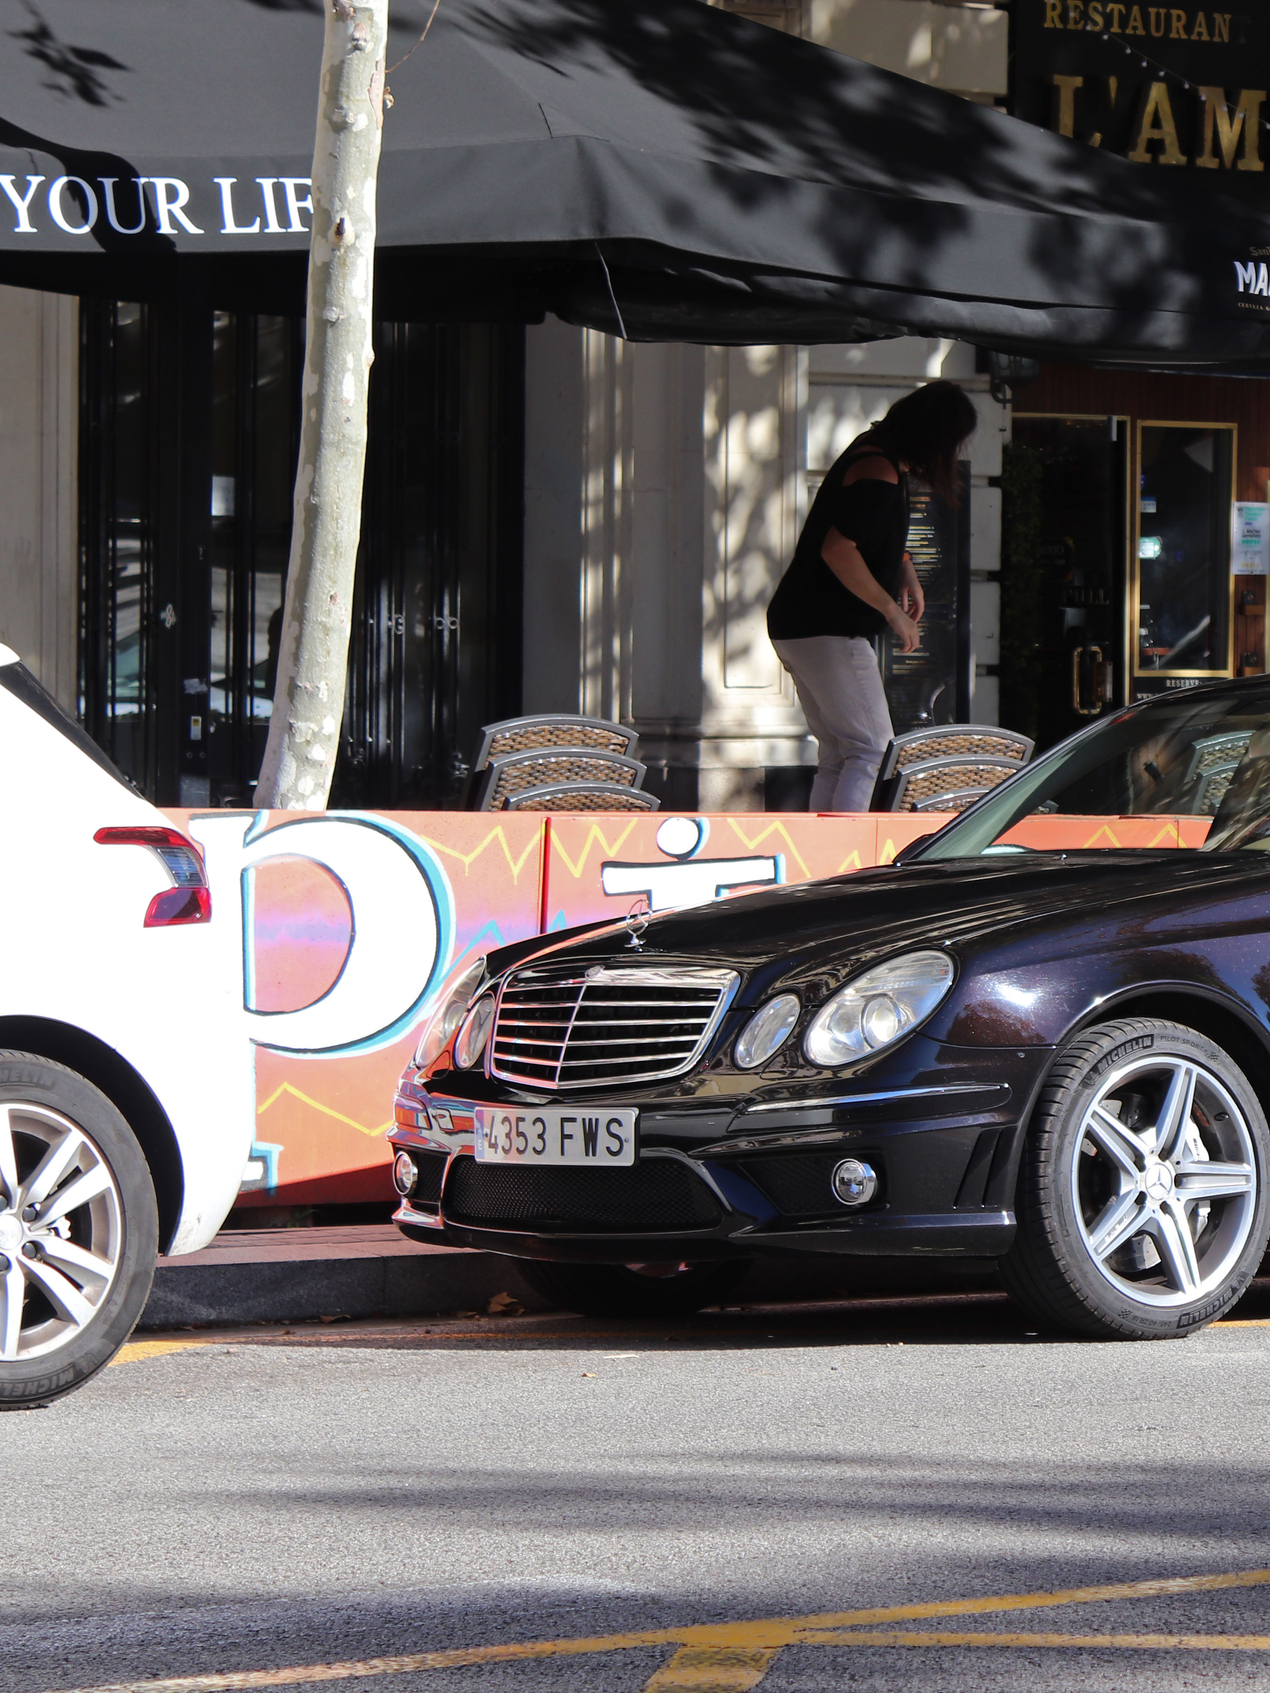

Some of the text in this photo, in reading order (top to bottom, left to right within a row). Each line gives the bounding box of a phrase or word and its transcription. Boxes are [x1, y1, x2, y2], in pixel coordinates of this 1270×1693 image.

[0, 174, 205, 235] YOUR
[1237, 301, 1264, 310] CERVEZA
[1166, 678, 1203, 689] RESERVE
[1098, 1034, 1204, 1074] MICHELIN PILOT SPORT
[487, 1115, 547, 1156] 4353
[560, 1116, 624, 1157] FWS
[1178, 1287, 1233, 1328] MICHELIN
